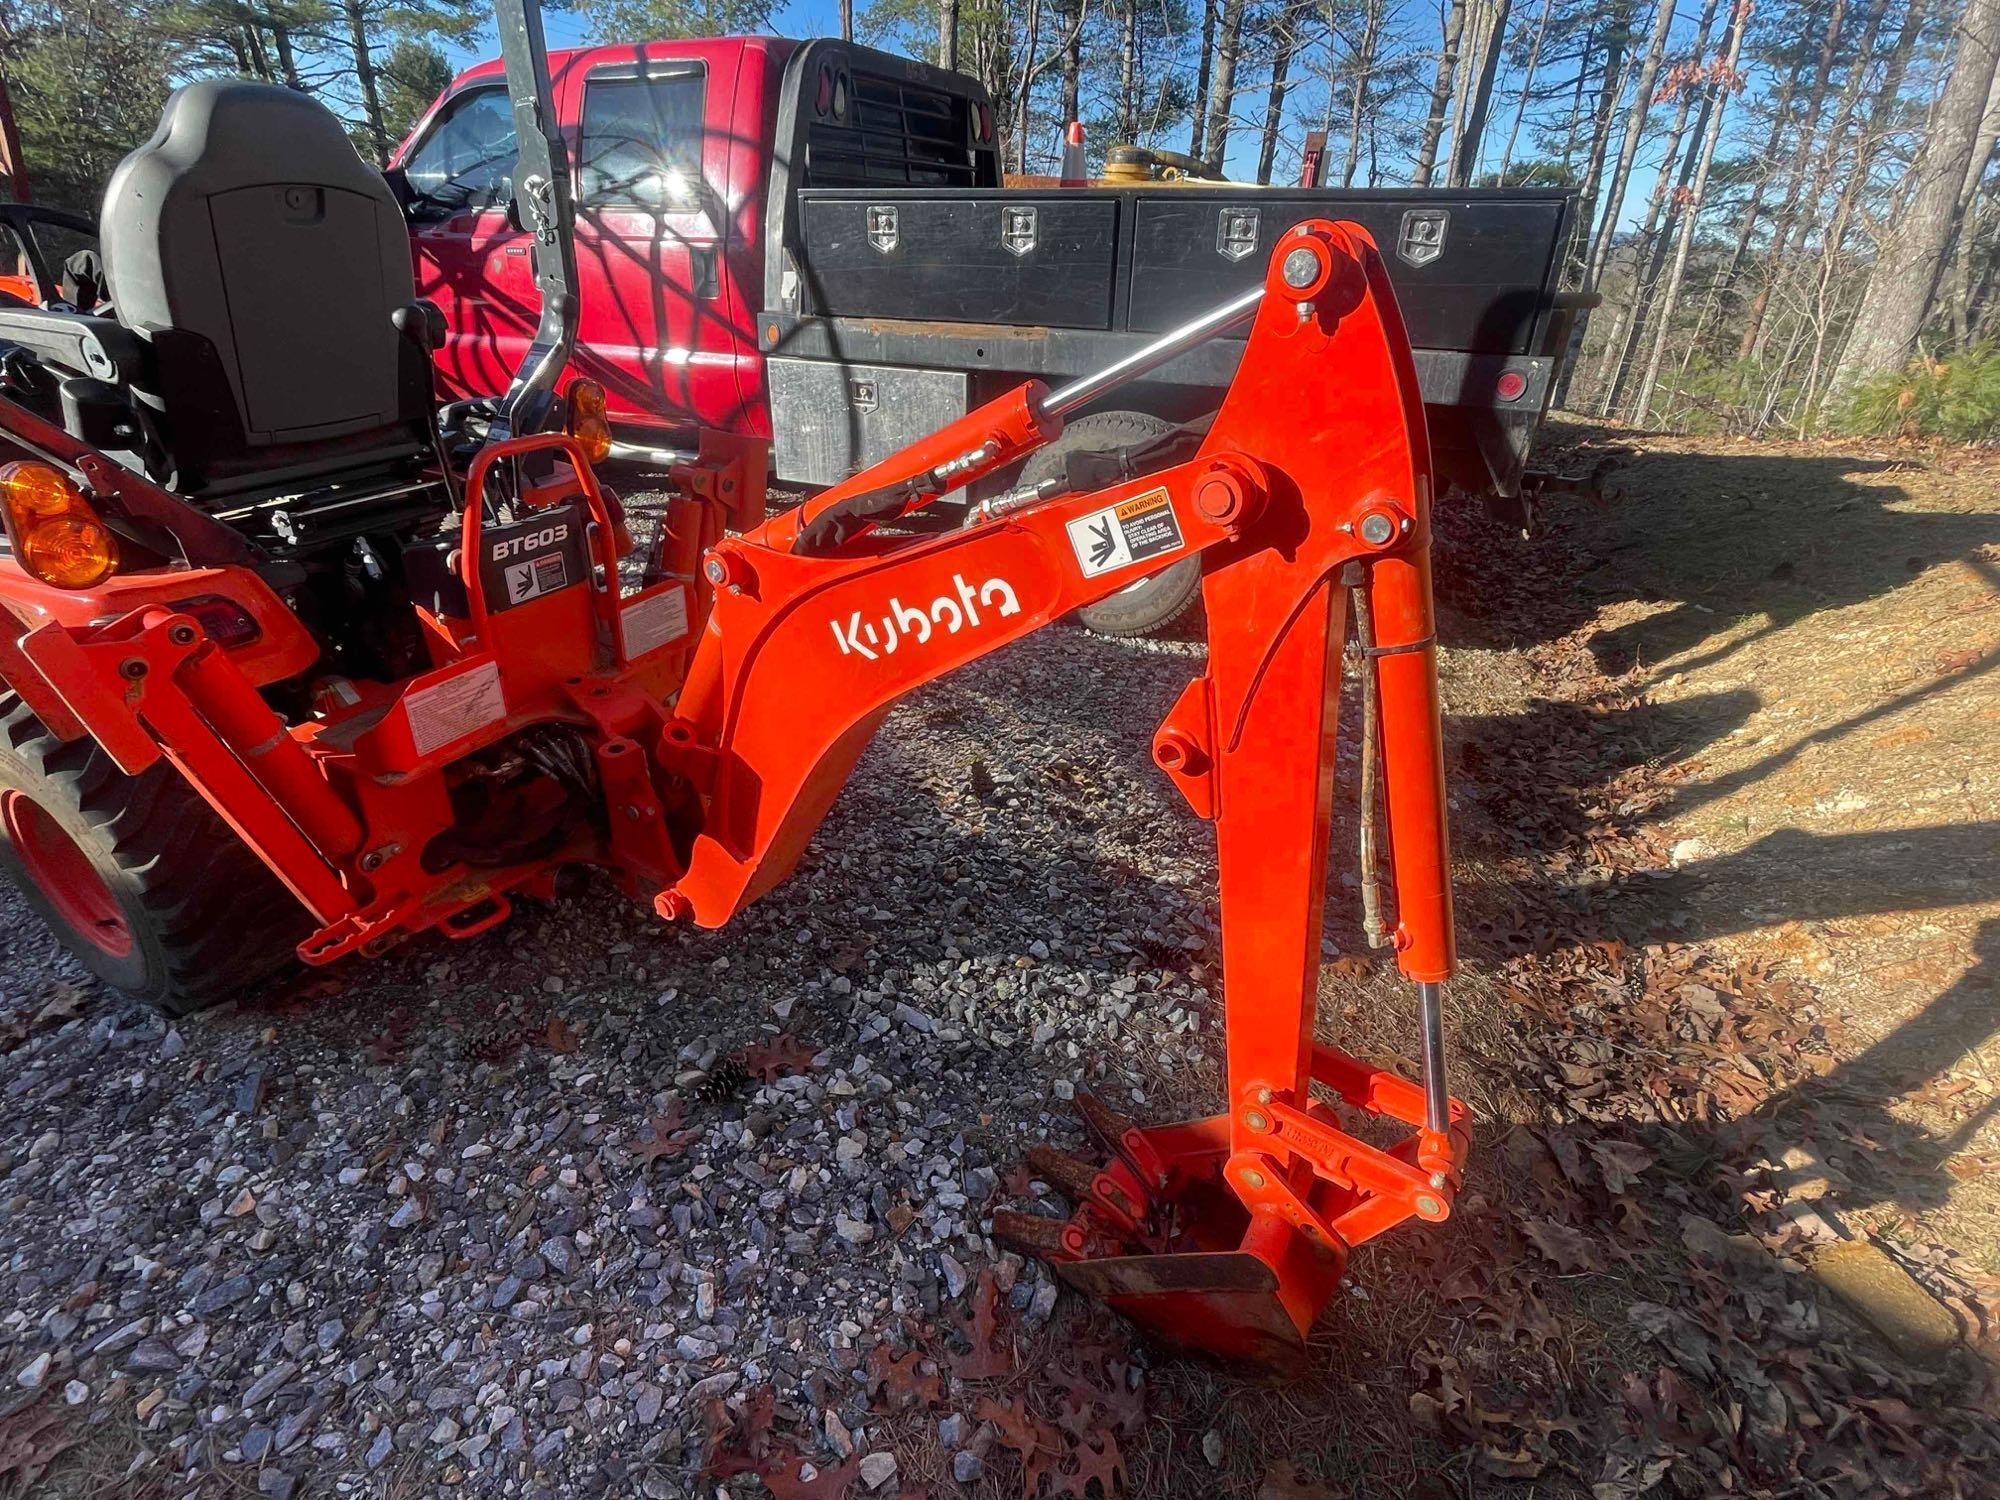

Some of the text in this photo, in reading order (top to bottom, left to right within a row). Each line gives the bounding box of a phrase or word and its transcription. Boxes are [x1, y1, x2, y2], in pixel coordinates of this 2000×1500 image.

[1127, 494, 1164, 513] WARNING
[1130, 518, 1144, 527] AVOID
[1144, 510, 1171, 522] PERSONAL
[1130, 526, 1171, 544] OPERATING AREA
[1140, 525, 1157, 534] CLEAR
[493, 524, 568, 562] BT603
[830, 573, 1021, 660] Kubota
